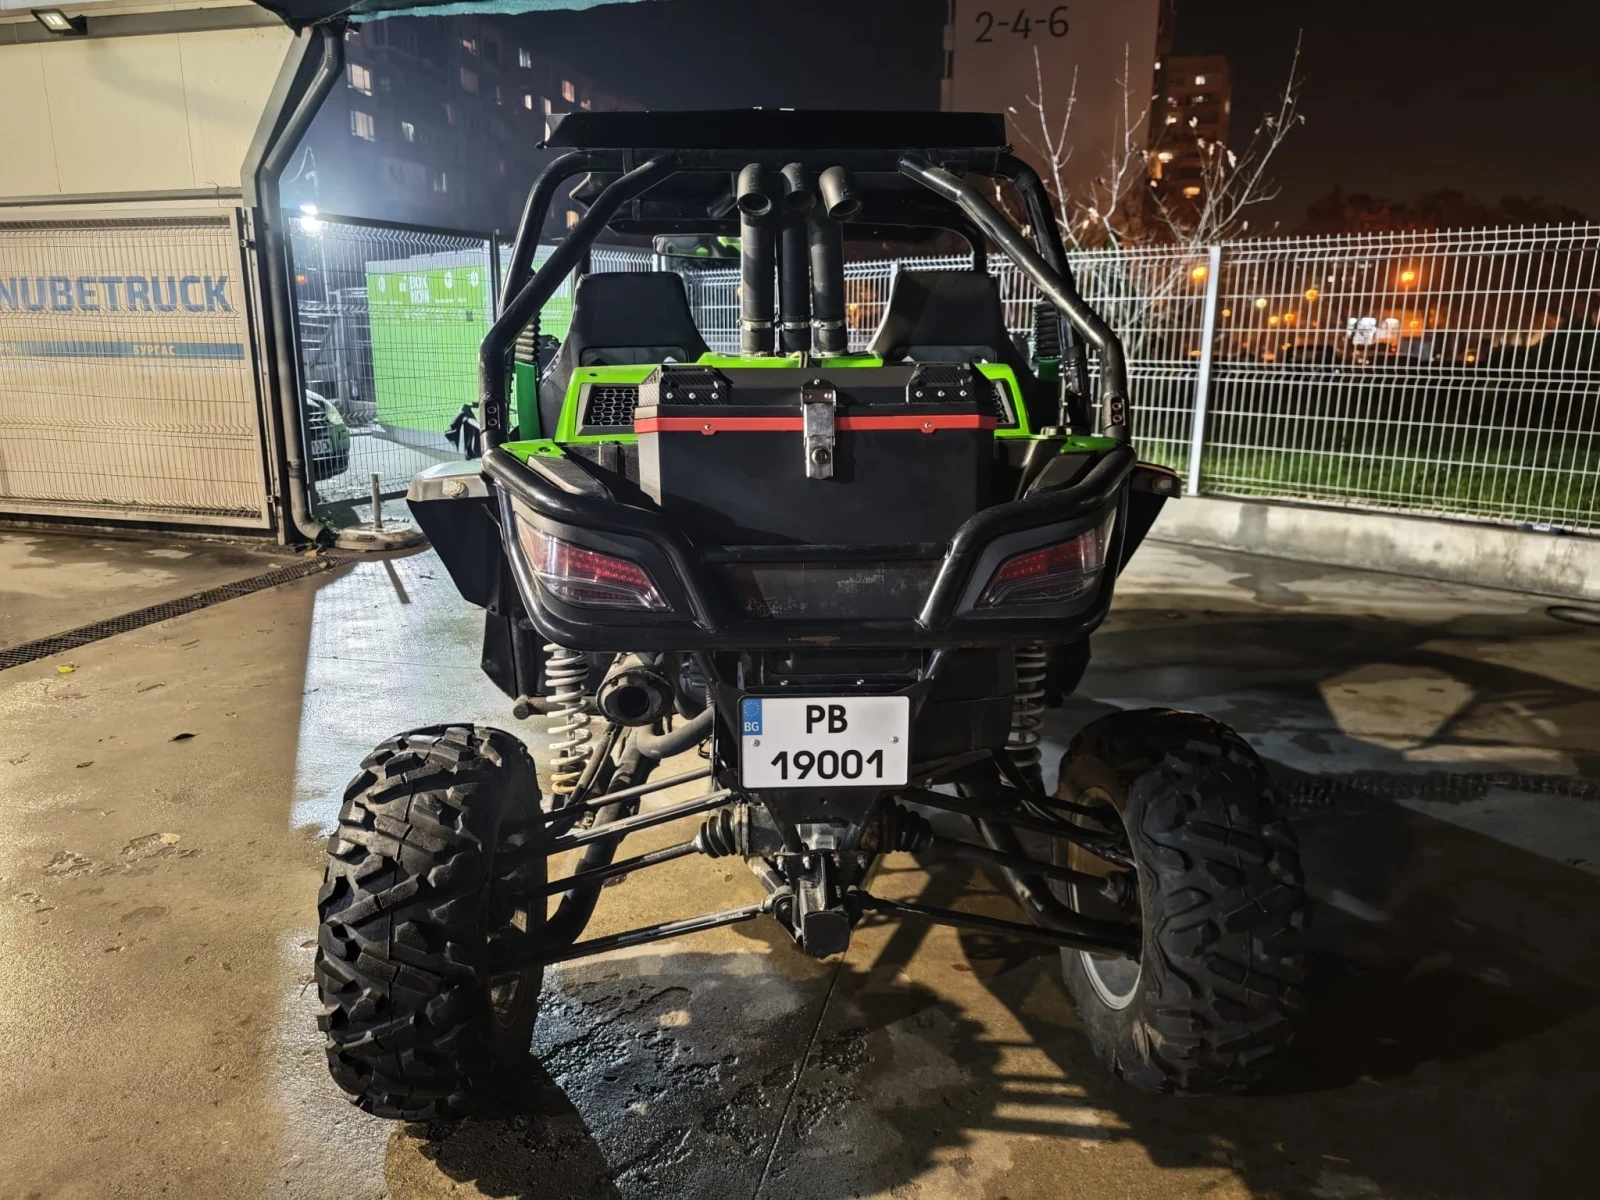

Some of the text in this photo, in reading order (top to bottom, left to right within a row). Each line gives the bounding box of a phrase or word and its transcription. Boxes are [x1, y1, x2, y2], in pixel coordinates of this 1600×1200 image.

[975, 5, 1069, 43] 2-4-6
[133, 344, 175, 356] БУРГАС
[744, 721, 760, 732] BG
[806, 704, 848, 734] PB
[770, 749, 883, 780] 19001
